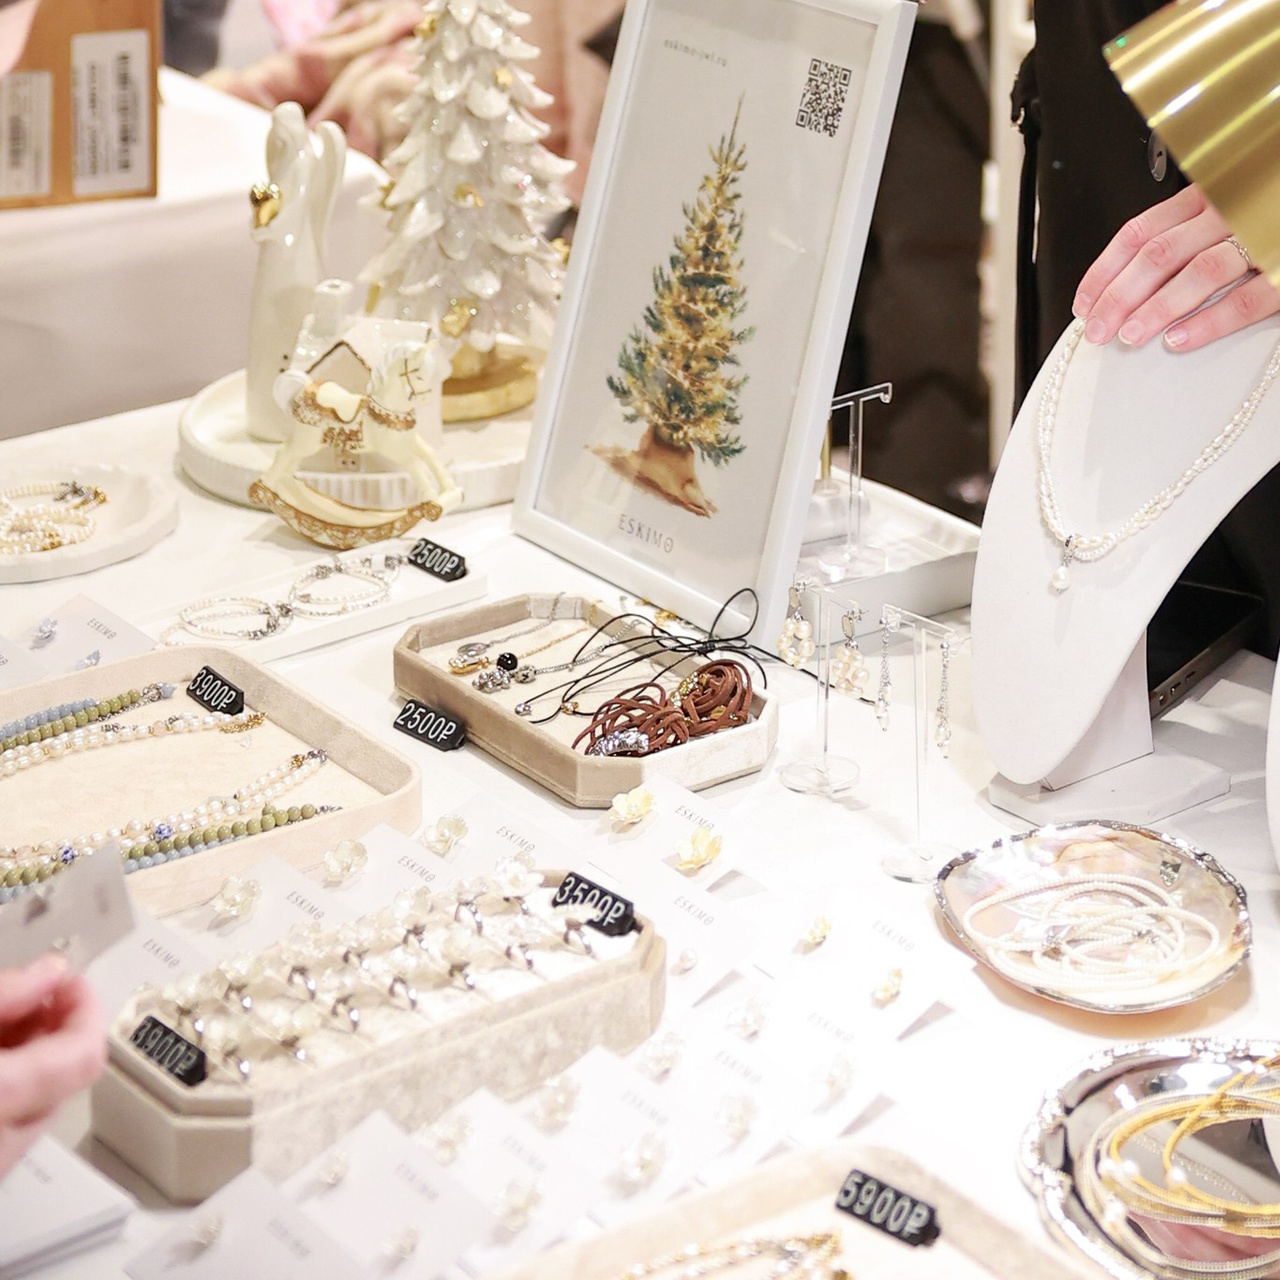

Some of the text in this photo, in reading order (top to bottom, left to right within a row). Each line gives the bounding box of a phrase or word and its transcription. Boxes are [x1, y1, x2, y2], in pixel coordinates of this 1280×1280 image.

[618, 513, 674, 553] ESKIMO
[409, 541, 460, 575] 2500₽
[188, 669, 237, 710] 3900₽
[397, 702, 458, 743] 2500₽
[675, 804, 716, 832] ESKIMO
[495, 825, 537, 853] ESKIMO
[397, 854, 437, 883] ESKIMO
[286, 890, 326, 920] ESKIMO
[673, 895, 715, 927] ESKIMO
[142, 938, 182, 968] ESKIMO
